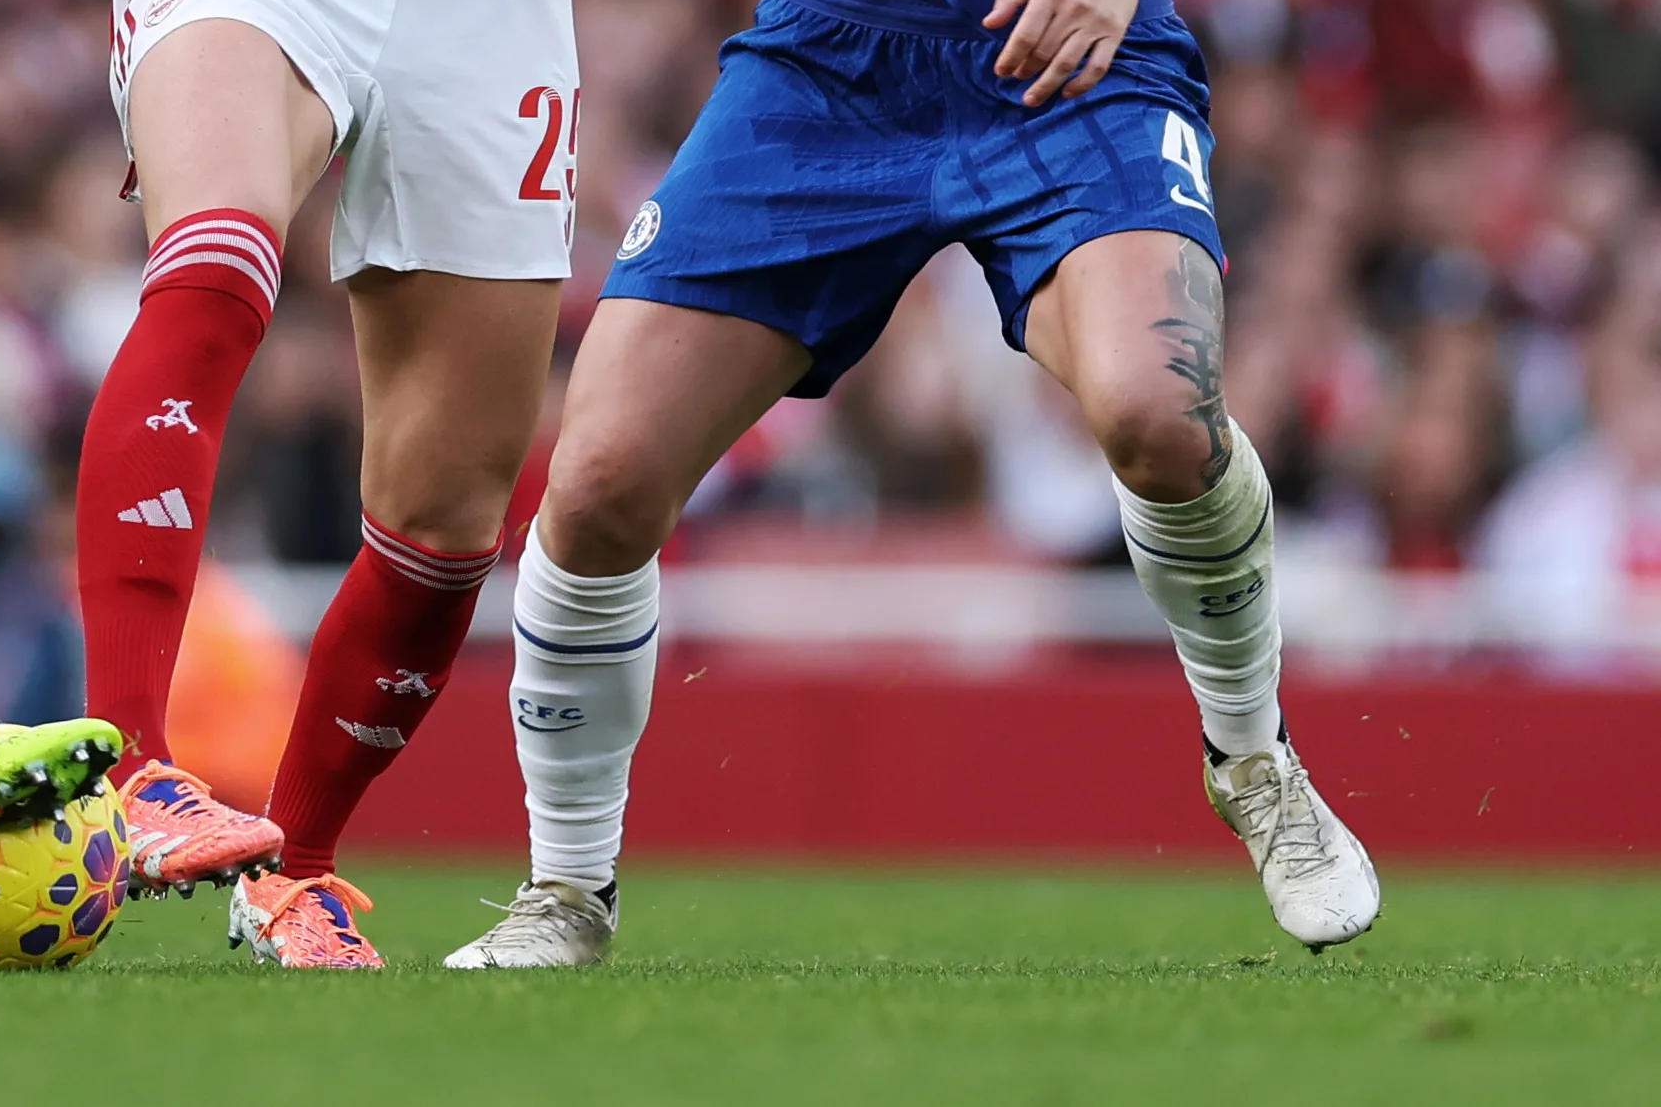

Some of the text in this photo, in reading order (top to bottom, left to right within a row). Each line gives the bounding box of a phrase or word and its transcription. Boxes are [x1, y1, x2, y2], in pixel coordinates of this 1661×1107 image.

[1162, 110, 1209, 203] 4
[1199, 576, 1265, 606] CFC
[518, 698, 584, 720] CFC
